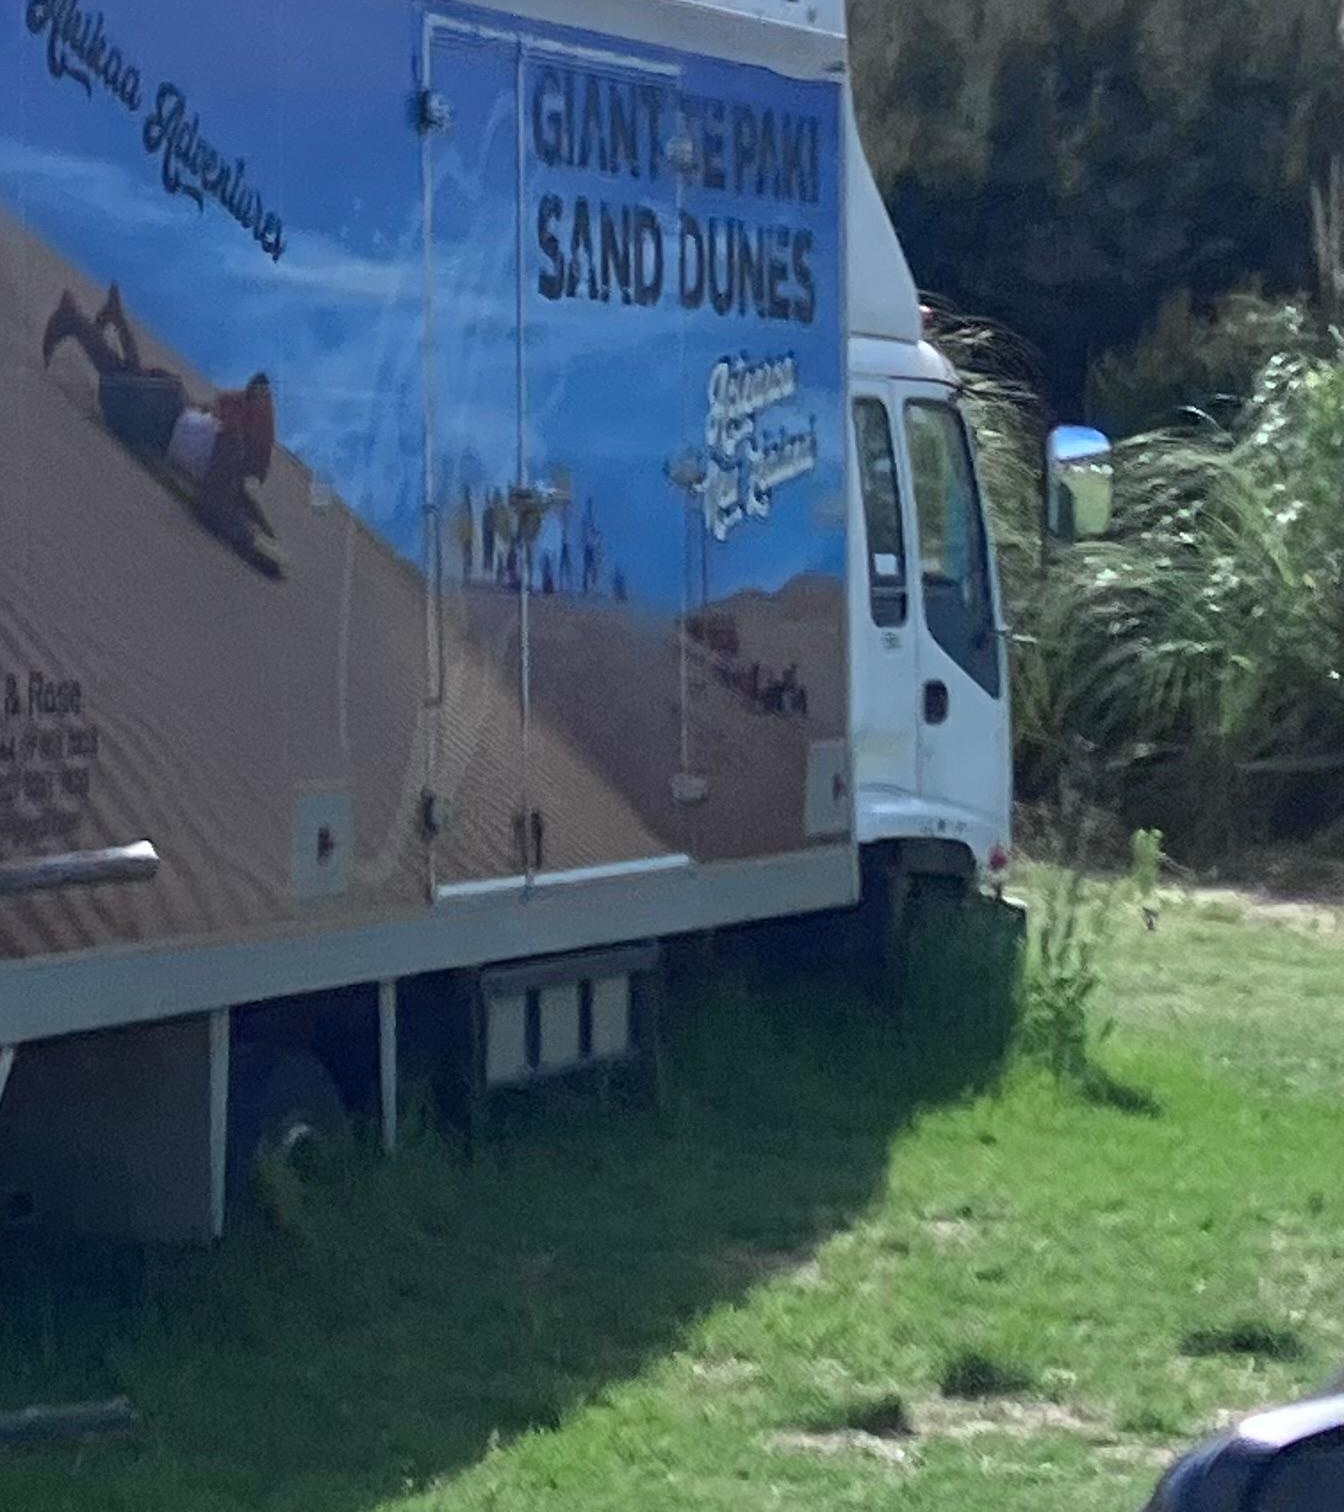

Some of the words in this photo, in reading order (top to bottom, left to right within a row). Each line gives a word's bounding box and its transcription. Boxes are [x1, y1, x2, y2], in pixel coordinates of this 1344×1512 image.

[532, 67, 665, 179] GIANT
[733, 105, 820, 205] PAKI
[537, 194, 664, 306] SAND
[678, 210, 813, 324] DUNES
